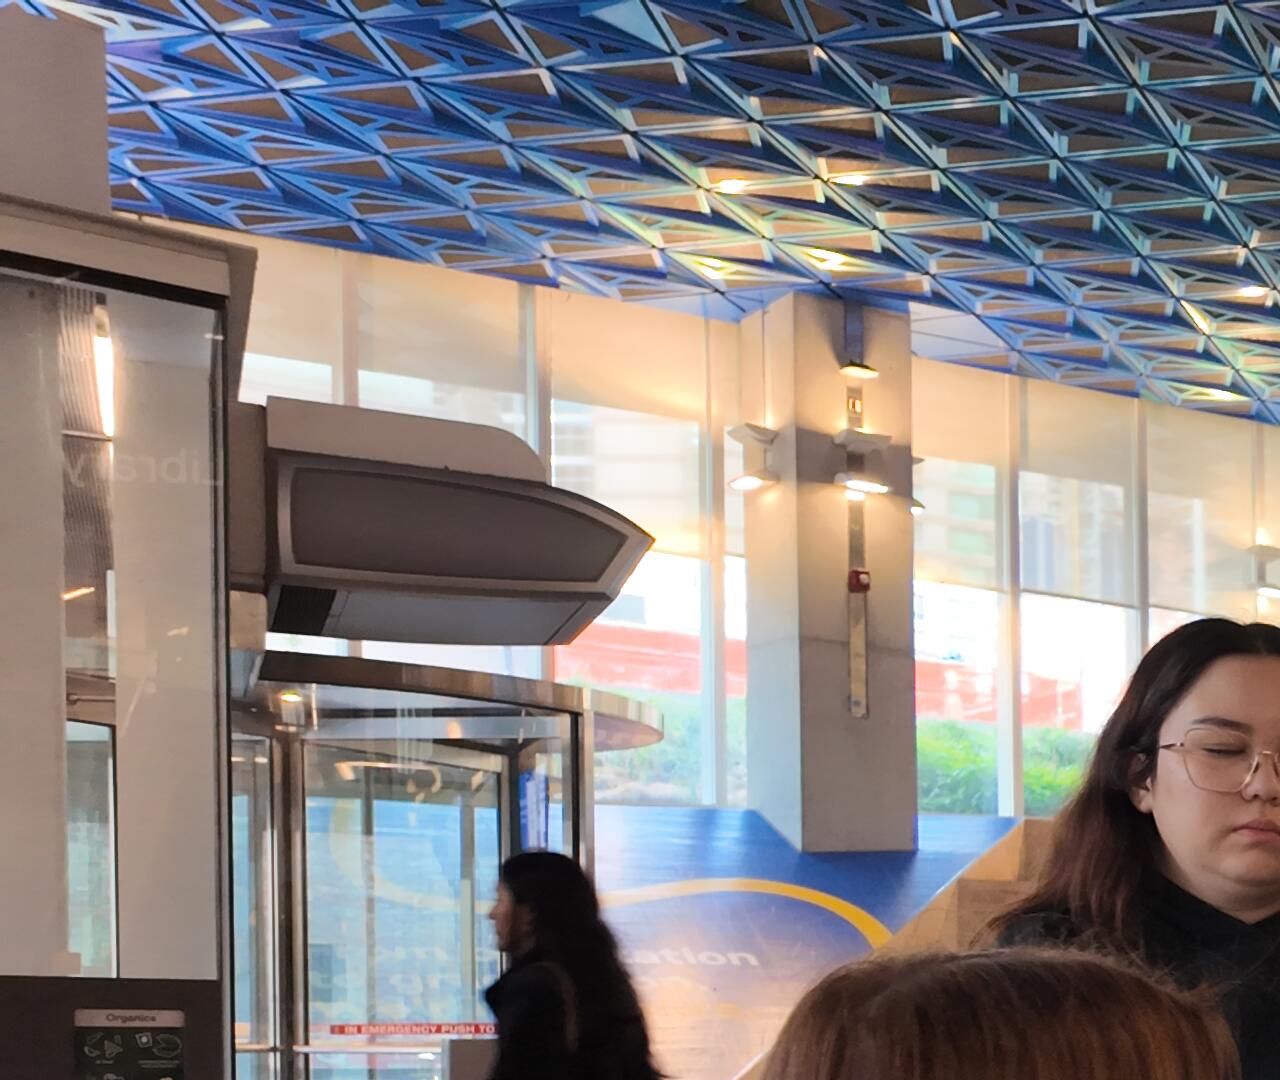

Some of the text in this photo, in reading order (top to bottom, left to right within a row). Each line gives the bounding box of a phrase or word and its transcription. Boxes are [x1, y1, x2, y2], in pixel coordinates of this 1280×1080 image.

[105, 1012, 157, 1024] Organics
[344, 1024, 496, 1034] IN EMERGENCY PUSH TO
